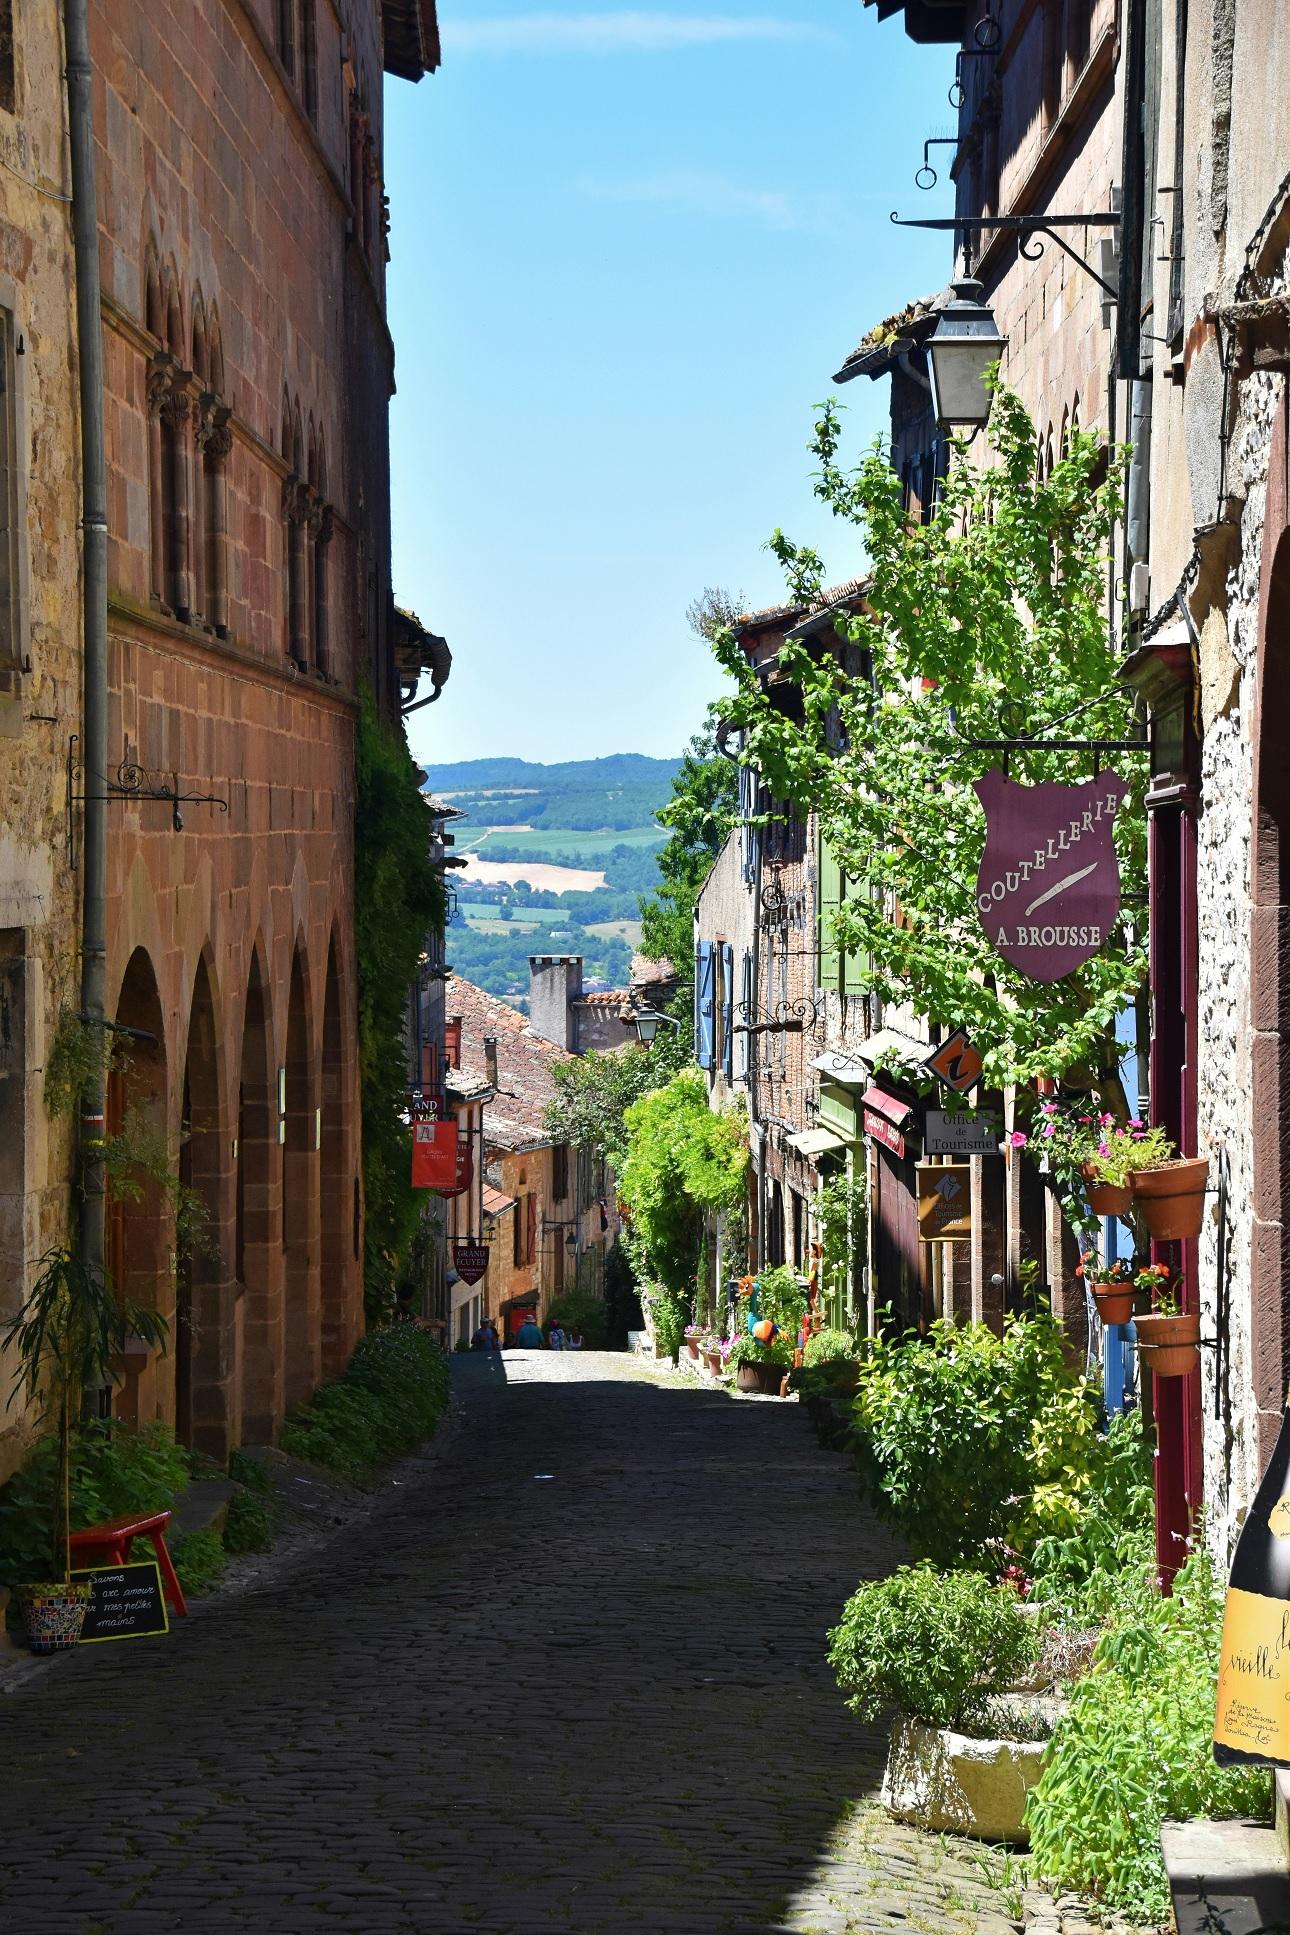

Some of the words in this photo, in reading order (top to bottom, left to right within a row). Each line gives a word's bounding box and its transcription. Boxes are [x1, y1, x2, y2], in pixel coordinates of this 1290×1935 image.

[978, 794, 1117, 912] COUTELLERIE
[996, 926, 1013, 946] A.
[1016, 926, 1101, 947] BROUSSE
[955, 1127, 967, 1136] de
[932, 1138, 993, 1150] Tourisme
[457, 1250, 486, 1258] GRAND
[88, 1572, 125, 1584] Savons
[122, 1586, 155, 1597] amour
[103, 1602, 123, 1612] mes
[123, 1599, 152, 1614] petites
[96, 1615, 136, 1627] mains
[1222, 1645, 1280, 1685] vieille
